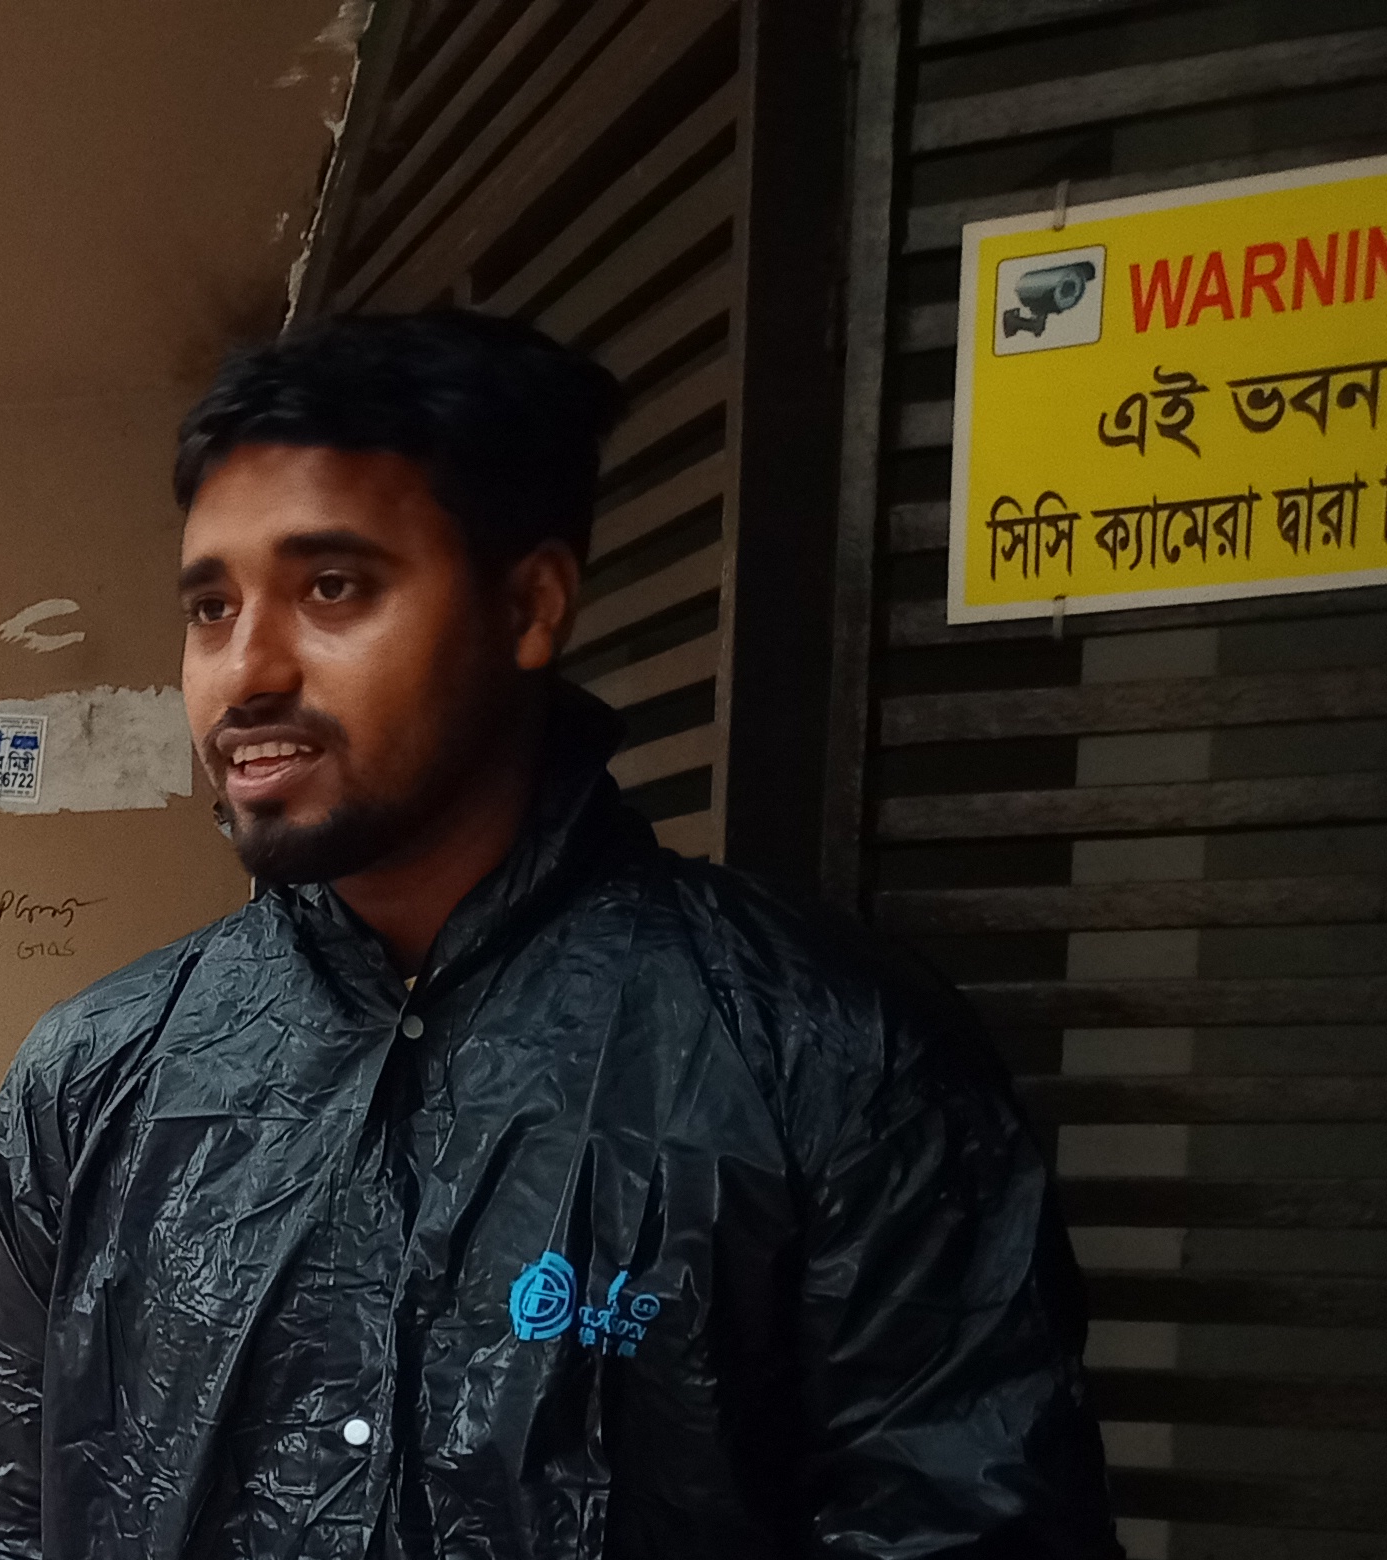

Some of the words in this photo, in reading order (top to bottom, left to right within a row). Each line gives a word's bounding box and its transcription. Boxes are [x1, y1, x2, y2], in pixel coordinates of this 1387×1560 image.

[1098, 365, 1211, 458] এই
[986, 490, 1082, 582] সিসি
[1091, 485, 1263, 571] ক্যামেরা
[1272, 471, 1369, 556] দ্বারা
